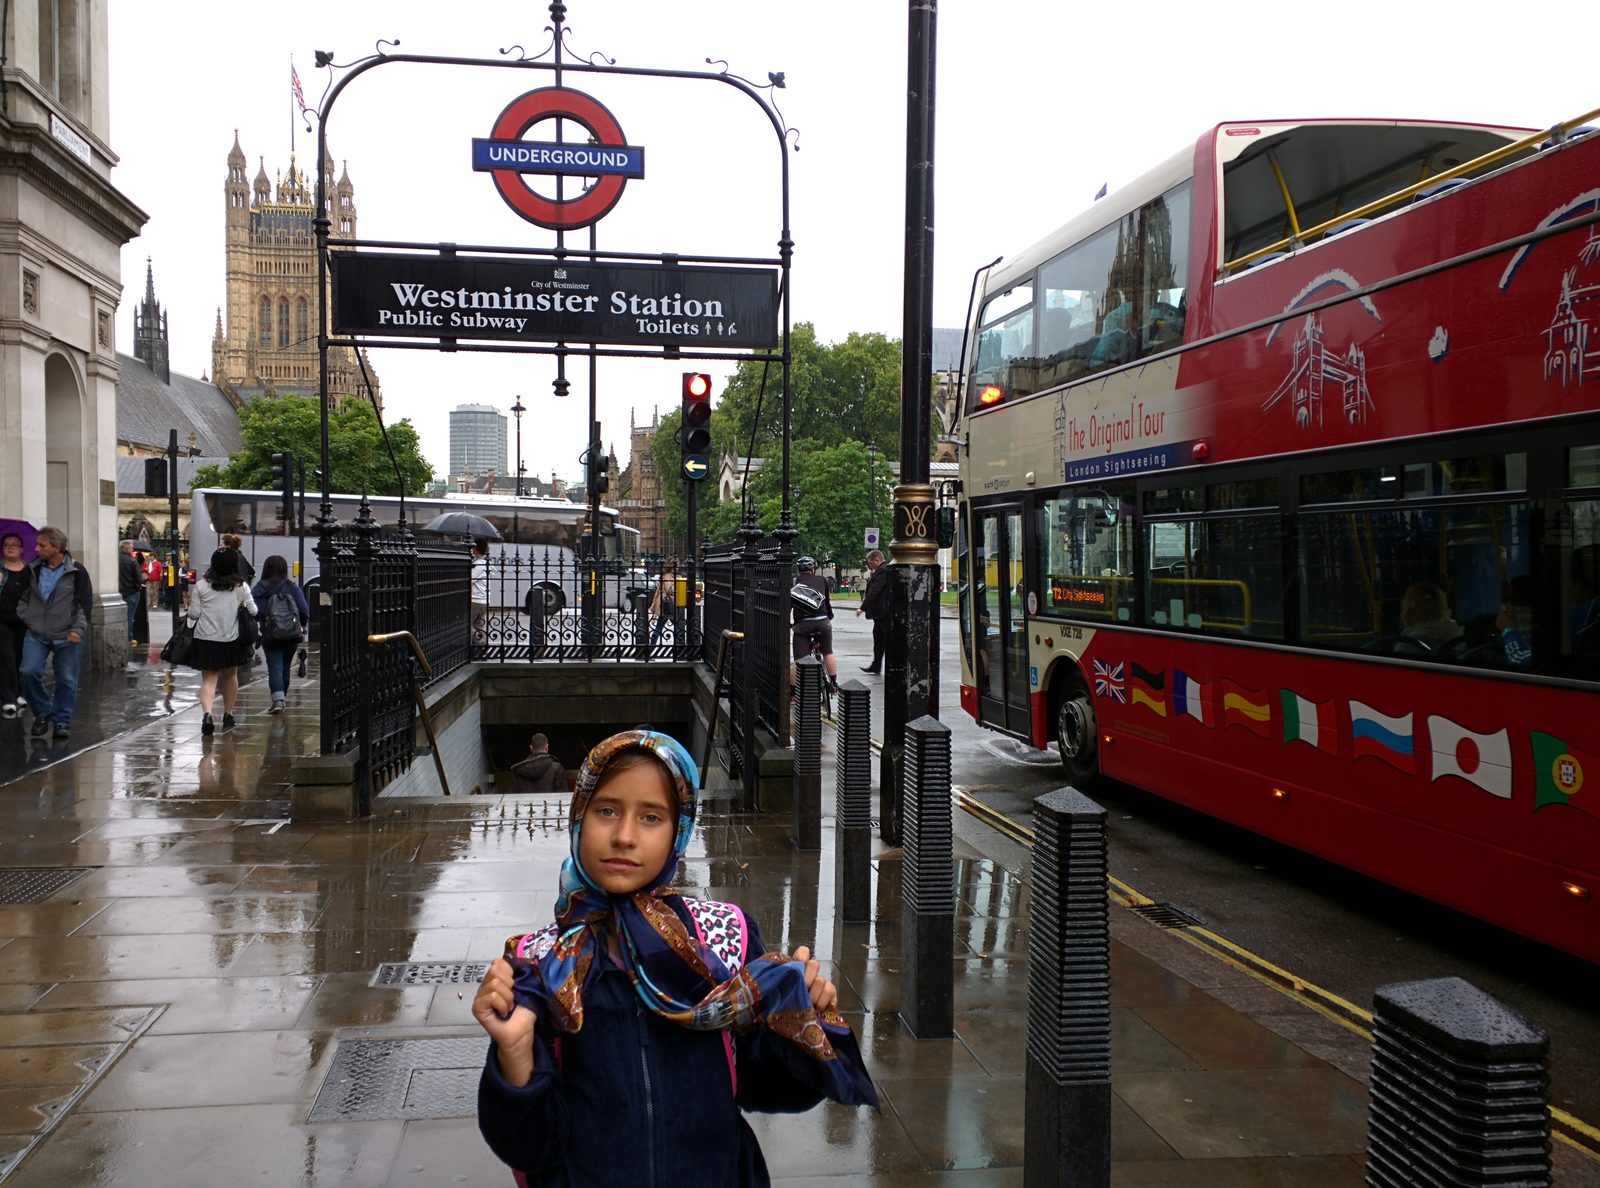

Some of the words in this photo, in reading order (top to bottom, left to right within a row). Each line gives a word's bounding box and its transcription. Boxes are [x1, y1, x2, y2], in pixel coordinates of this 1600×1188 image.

[489, 147, 628, 167] UNDERGROUND
[531, 280, 543, 290] City
[544, 280, 552, 288] of
[552, 281, 590, 290] Westminster
[390, 283, 599, 313] Westminster
[610, 290, 724, 318] Station
[378, 310, 443, 326] Public
[450, 311, 528, 333] Subway
[636, 318, 699, 335] Toilets
[1069, 417, 1085, 451] The
[1089, 402, 1133, 453] Original
[1138, 402, 1165, 438] Tour
[1069, 464, 1100, 478] London
[1104, 454, 1166, 474] Sightseeing
[1060, 625, 1072, 638] VXE
